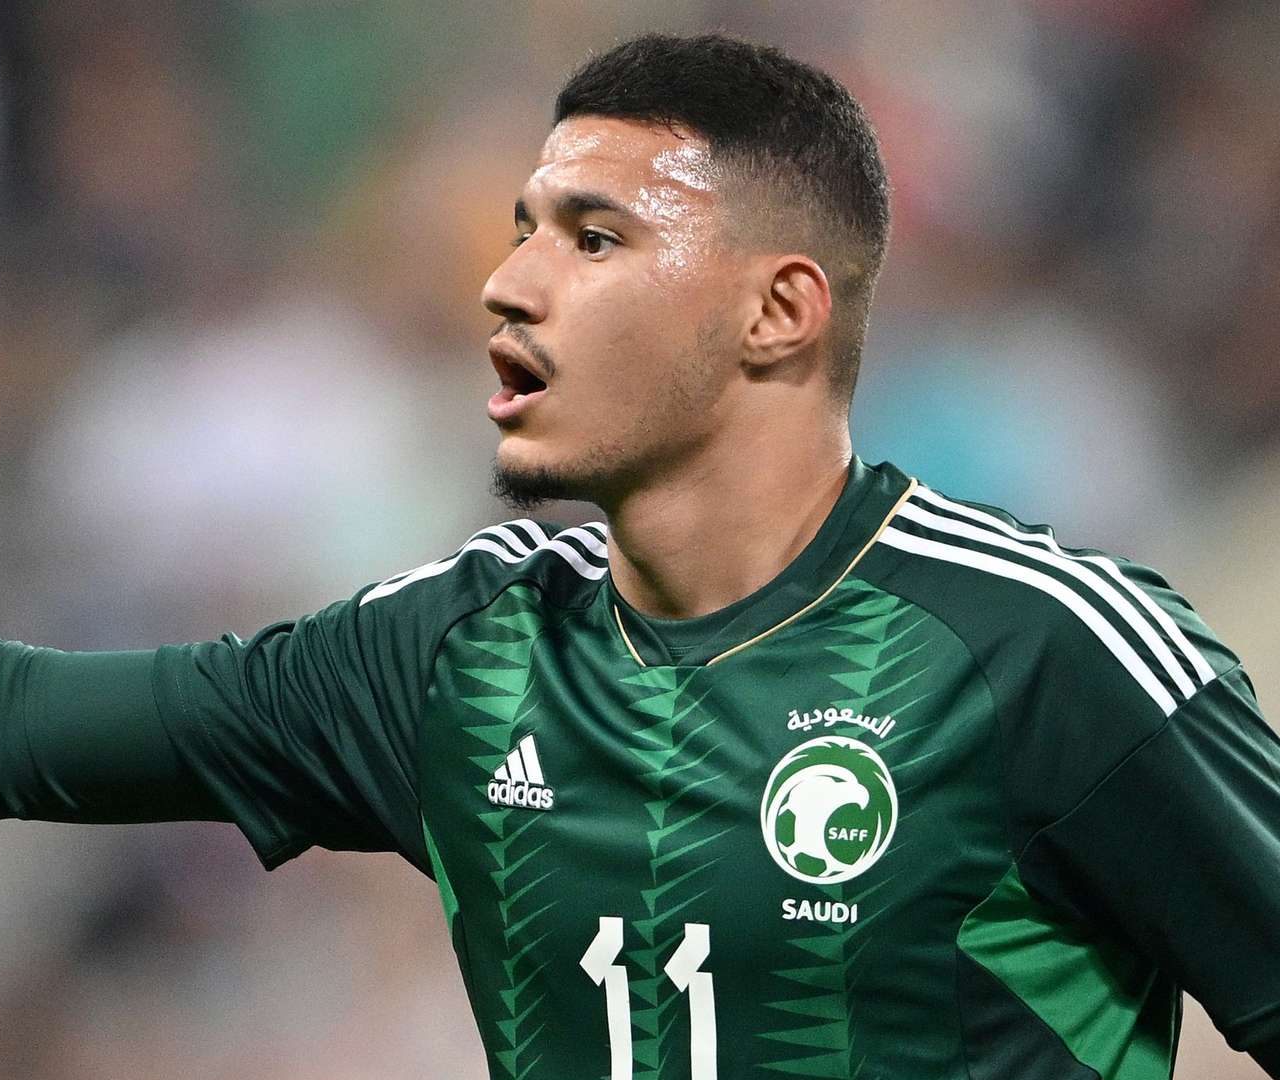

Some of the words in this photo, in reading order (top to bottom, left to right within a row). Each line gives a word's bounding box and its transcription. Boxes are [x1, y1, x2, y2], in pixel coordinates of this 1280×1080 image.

[787, 707, 896, 739] السعودية
[488, 779, 554, 808] adidas
[828, 827, 869, 842] SAFF
[782, 898, 858, 924] SAUDI
